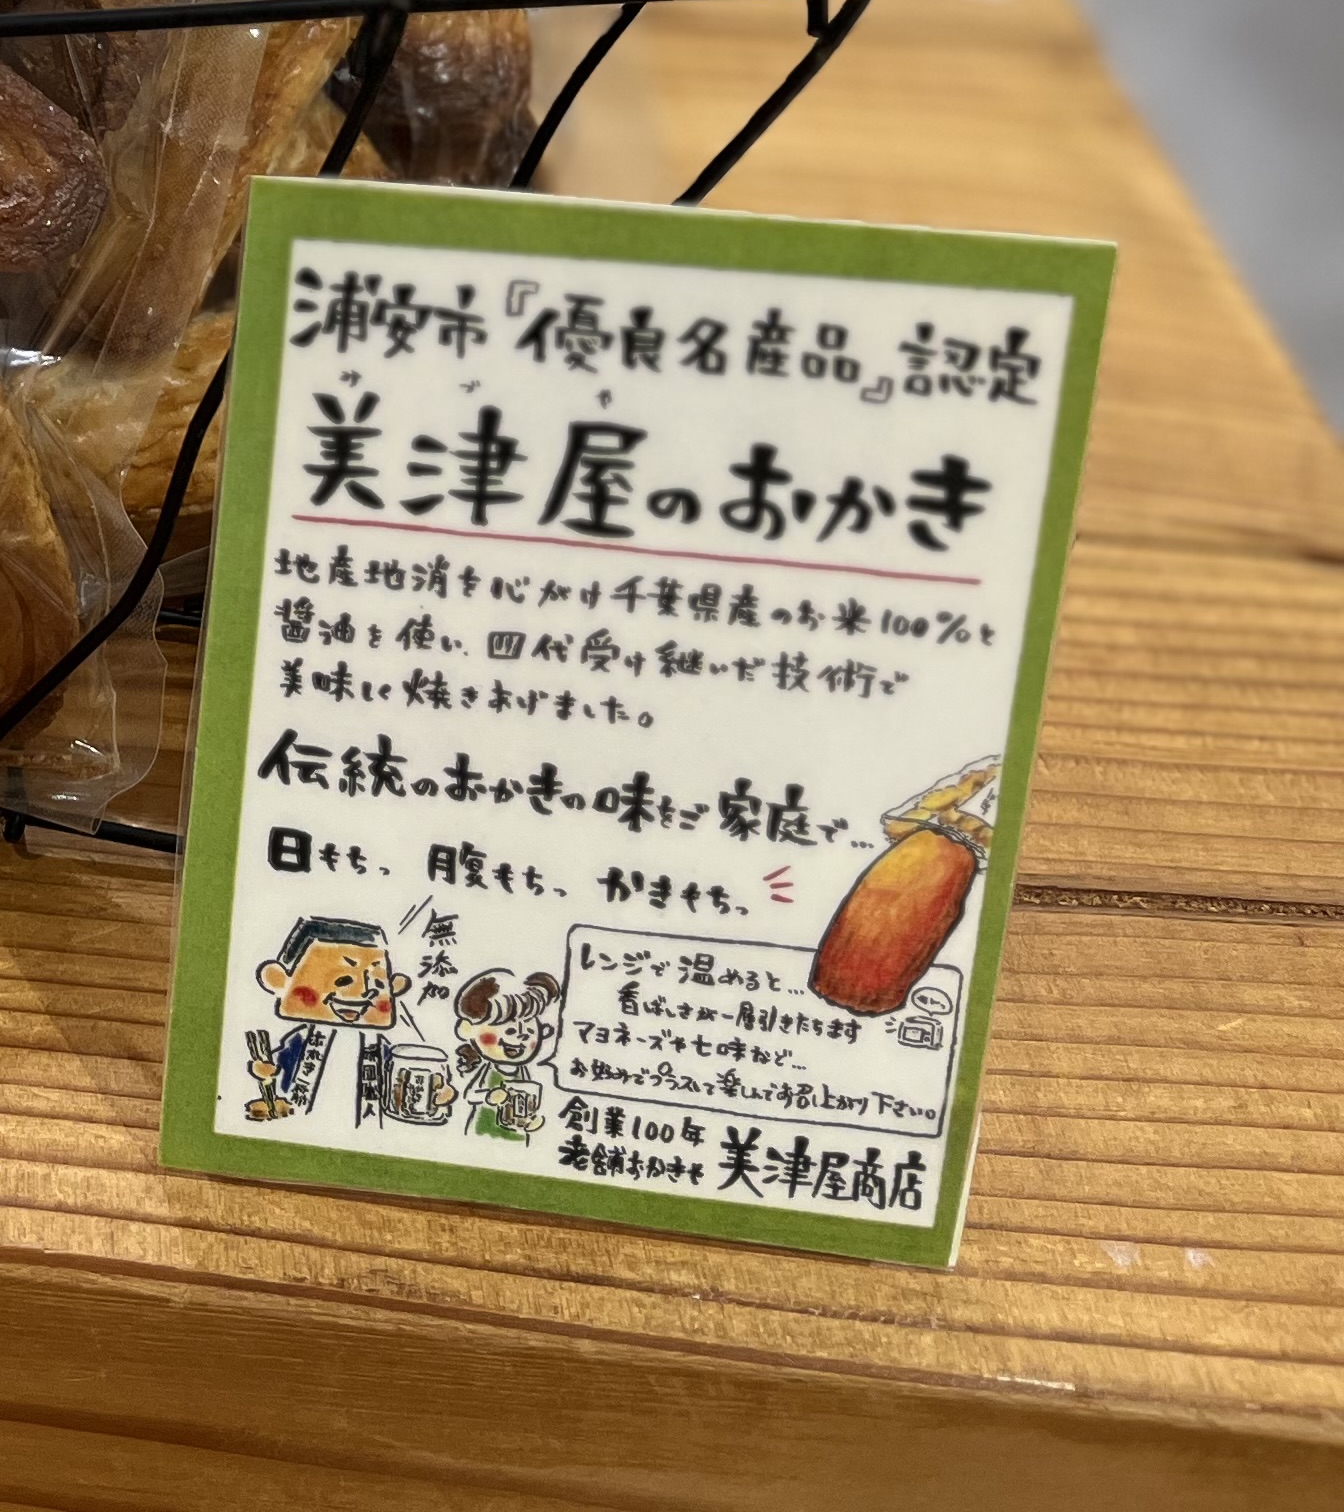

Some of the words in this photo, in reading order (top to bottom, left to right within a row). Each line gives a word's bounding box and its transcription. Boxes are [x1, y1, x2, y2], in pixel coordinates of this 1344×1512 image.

[289, 266, 1041, 406] 浦安市『優良名産品』認定
[301, 390, 993, 553] 美津屋のおかき
[279, 656, 654, 728] 美味しく焼きあげました。
[417, 909, 459, 1005] 無添加
[558, 1096, 706, 1147] 創業100年
[558, 1134, 704, 1186] 老舗おかきや
[717, 1125, 926, 1210] 美津屋商店
